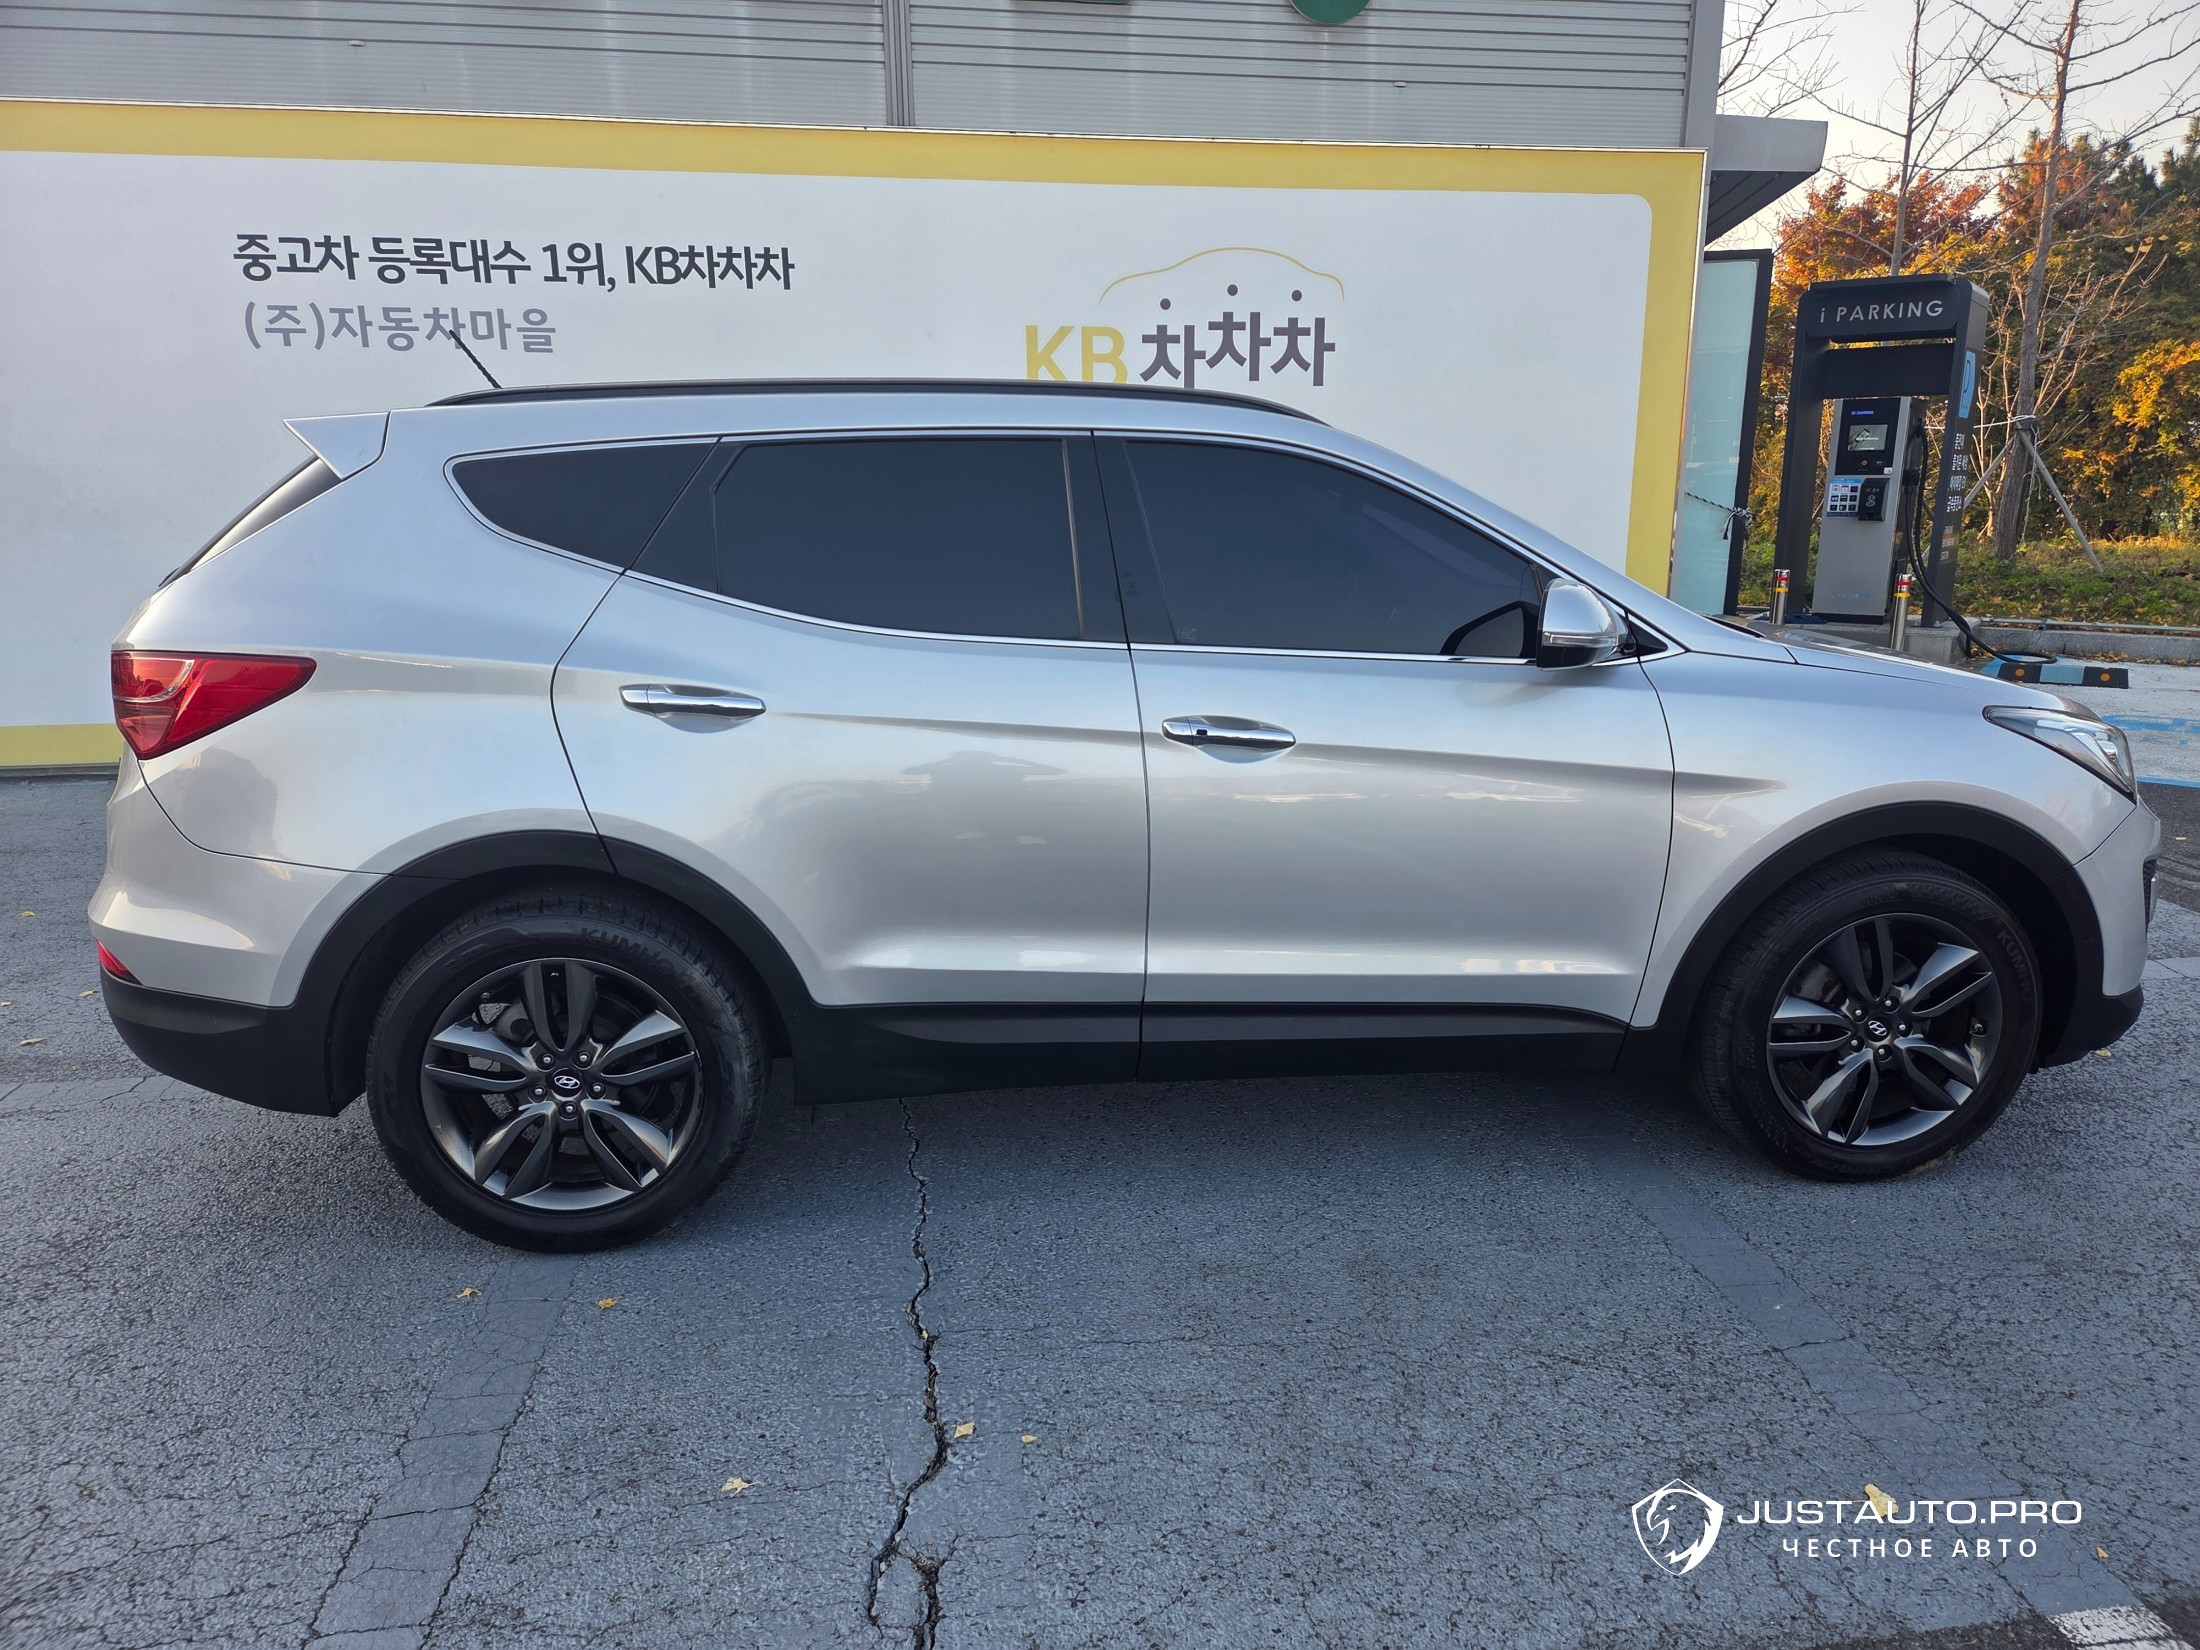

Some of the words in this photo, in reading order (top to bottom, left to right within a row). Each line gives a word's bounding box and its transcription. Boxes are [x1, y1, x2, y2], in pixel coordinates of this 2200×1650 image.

[233, 233, 359, 282] 중고차
[368, 236, 532, 285] 등록대수
[542, 242, 617, 293] 1위,
[625, 243, 795, 290] KB차차차
[244, 300, 557, 353] (주)자동차마을
[1836, 299, 1944, 323] PARKING
[580, 927, 675, 976] KUMHO
